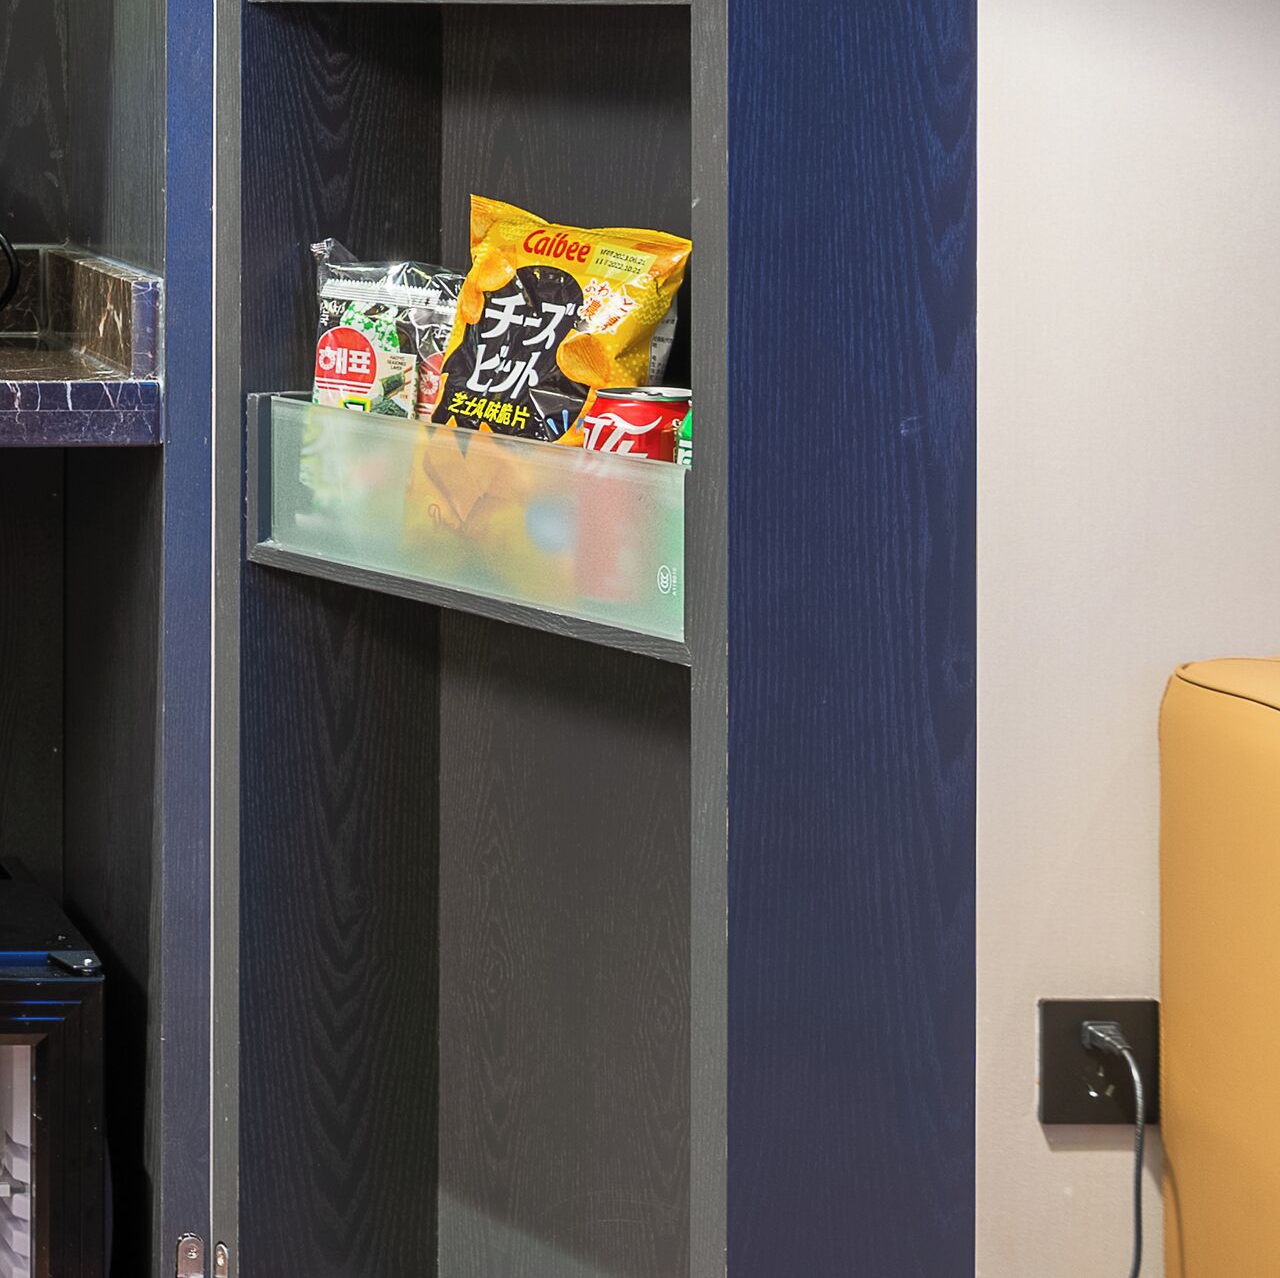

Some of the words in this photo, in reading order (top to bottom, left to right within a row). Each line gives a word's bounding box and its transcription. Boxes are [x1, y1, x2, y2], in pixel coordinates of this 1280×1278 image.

[523, 229, 592, 263] Calbee
[481, 292, 576, 350] チーズ
[318, 346, 371, 375] 해표
[466, 344, 541, 399] ビット
[448, 391, 531, 429] 芝士风味脆片
